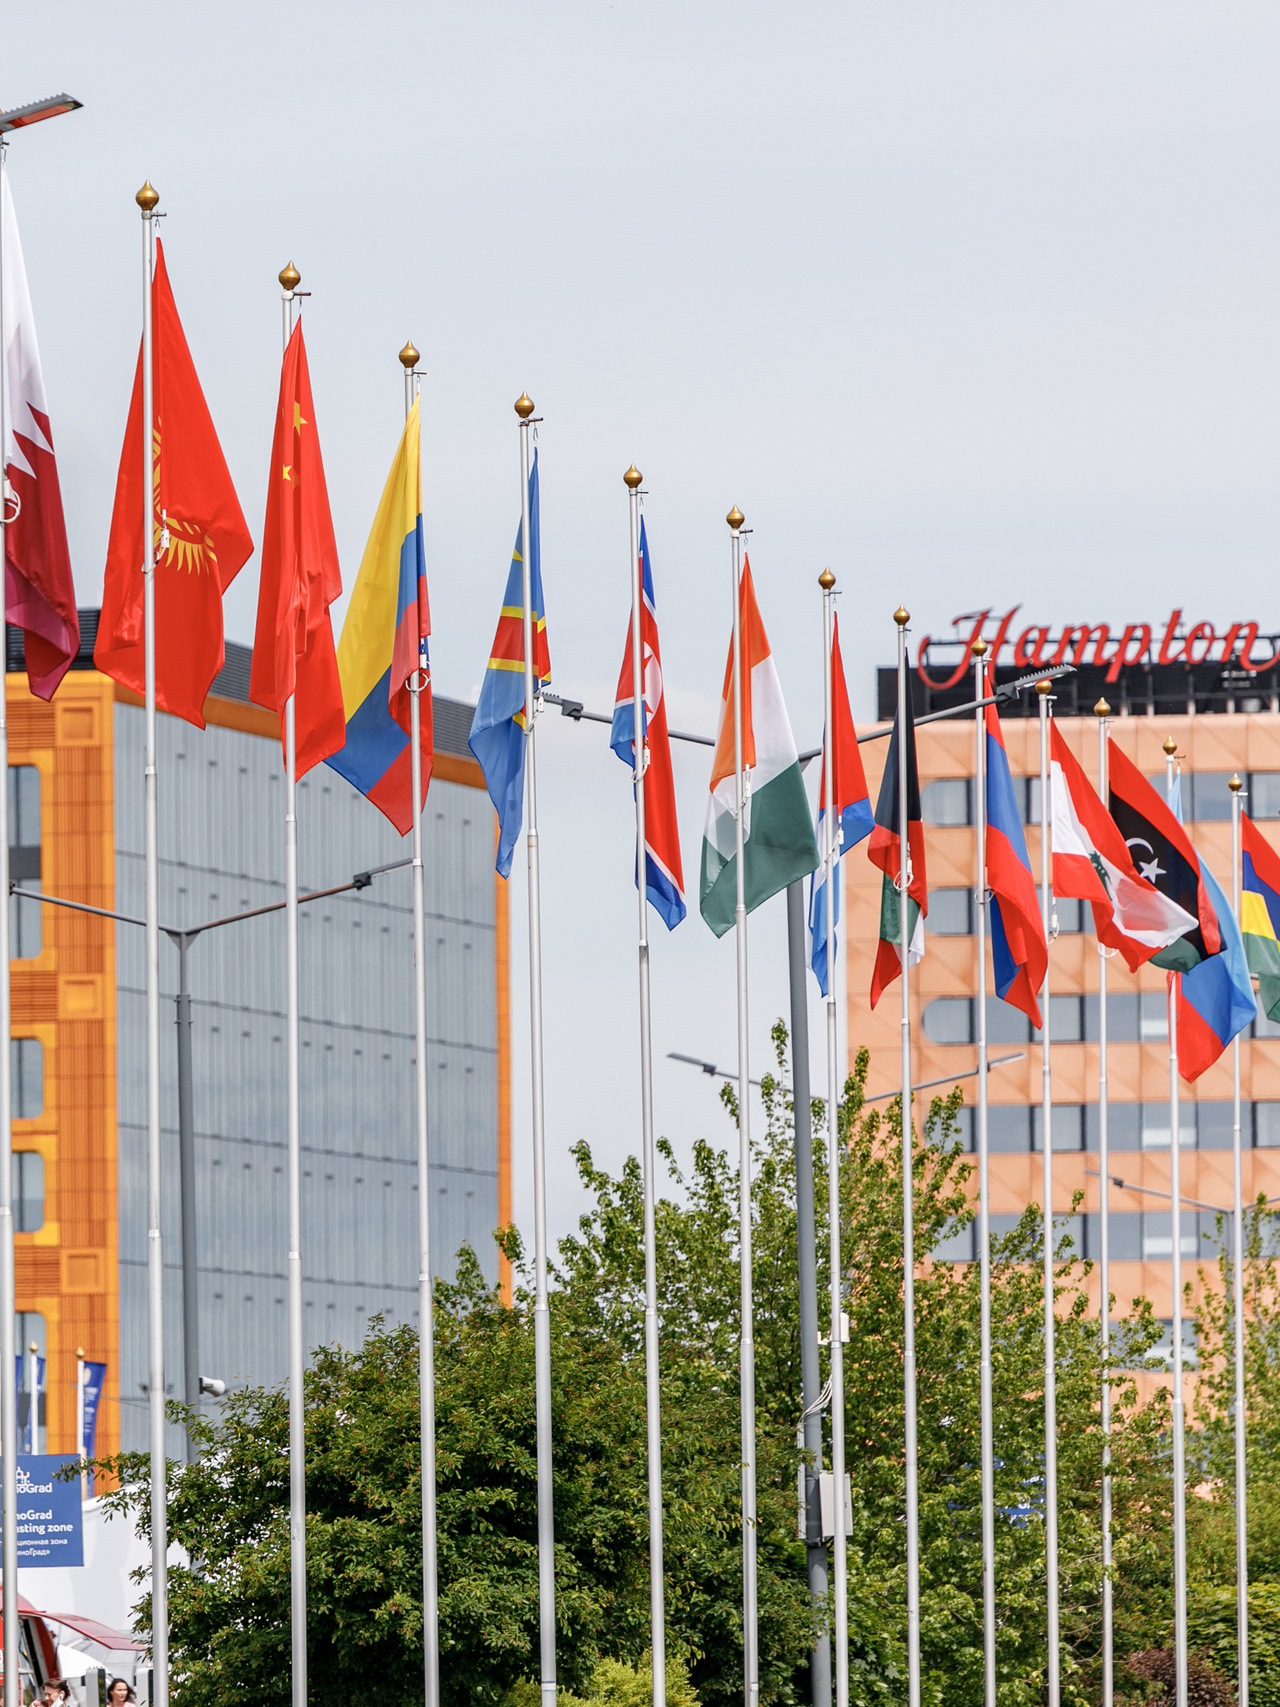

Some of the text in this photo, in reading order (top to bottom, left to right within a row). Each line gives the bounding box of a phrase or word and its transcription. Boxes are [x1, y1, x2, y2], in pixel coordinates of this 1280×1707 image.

[917, 602, 1280, 690] Hampton
[0, 1482, 53, 1494] noGrad
[1, 1509, 53, 1521] noGrad
[47, 1524, 74, 1533] zone
